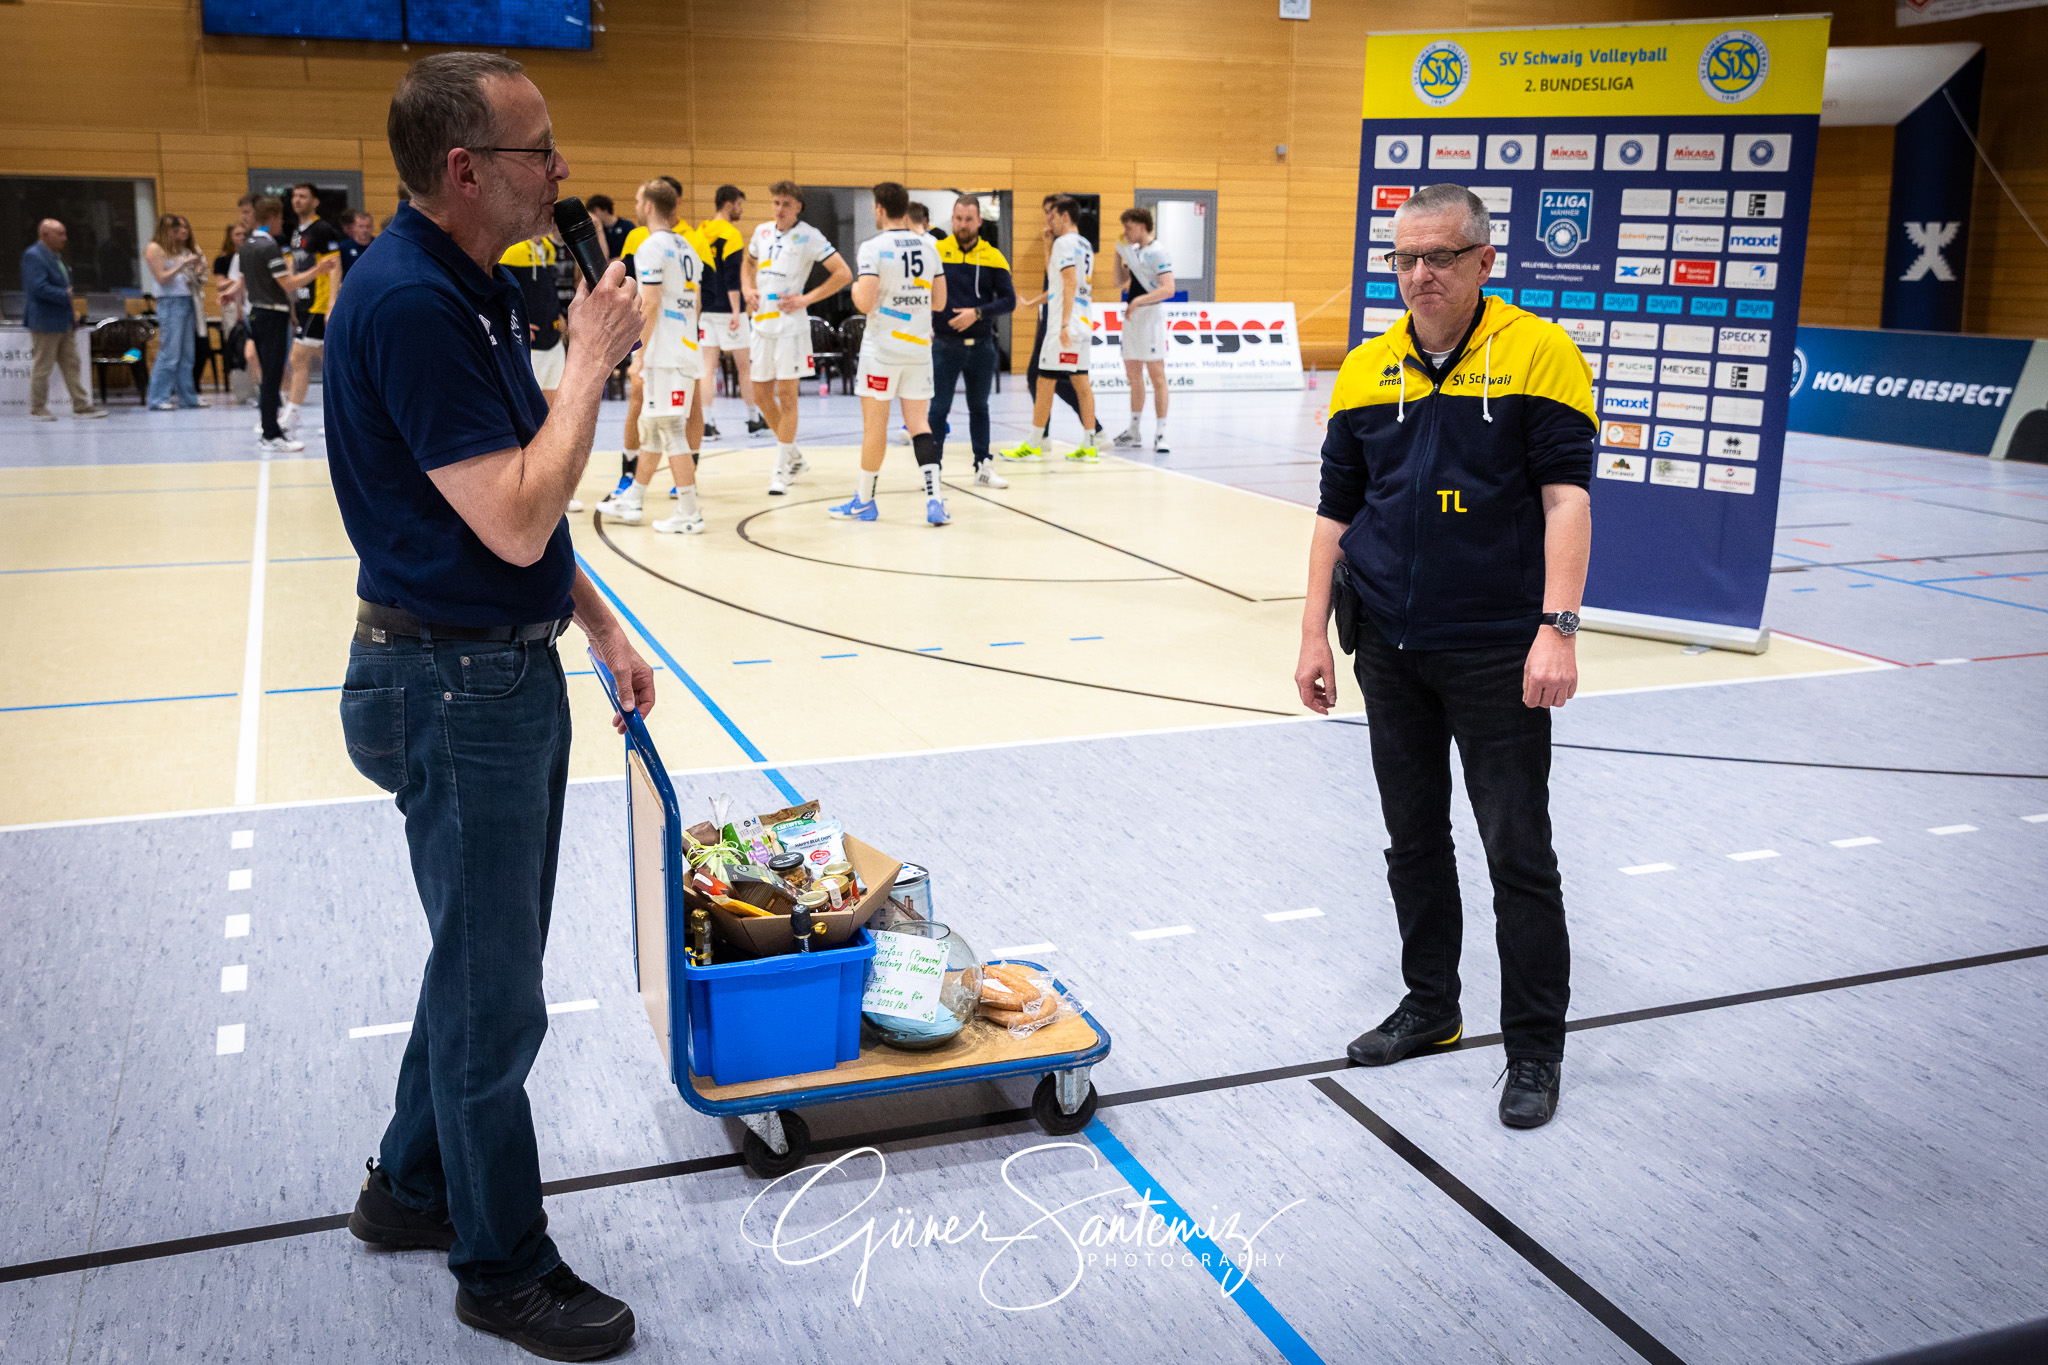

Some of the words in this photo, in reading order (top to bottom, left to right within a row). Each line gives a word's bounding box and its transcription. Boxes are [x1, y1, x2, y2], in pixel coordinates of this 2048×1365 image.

[1499, 52, 1517, 66] SV
[1523, 51, 1583, 67] Schwaig
[1589, 47, 1667, 66] Volleyball
[1524, 79, 1536, 92] 2.
[1540, 77, 1634, 91] BUNDESLIGA
[1730, 234, 1779, 247] maxit
[768, 245, 783, 260] 17
[902, 251, 924, 278] 15
[1720, 331, 1756, 342] SPECK
[1662, 365, 1707, 376] MEYSEL
[1452, 374, 1466, 386] SV
[1812, 371, 1876, 395] HOME
[1876, 377, 1908, 398] OF
[1907, 379, 2012, 407] RESPECT
[1604, 397, 1649, 410] maxit
[1436, 490, 1468, 513] TL
